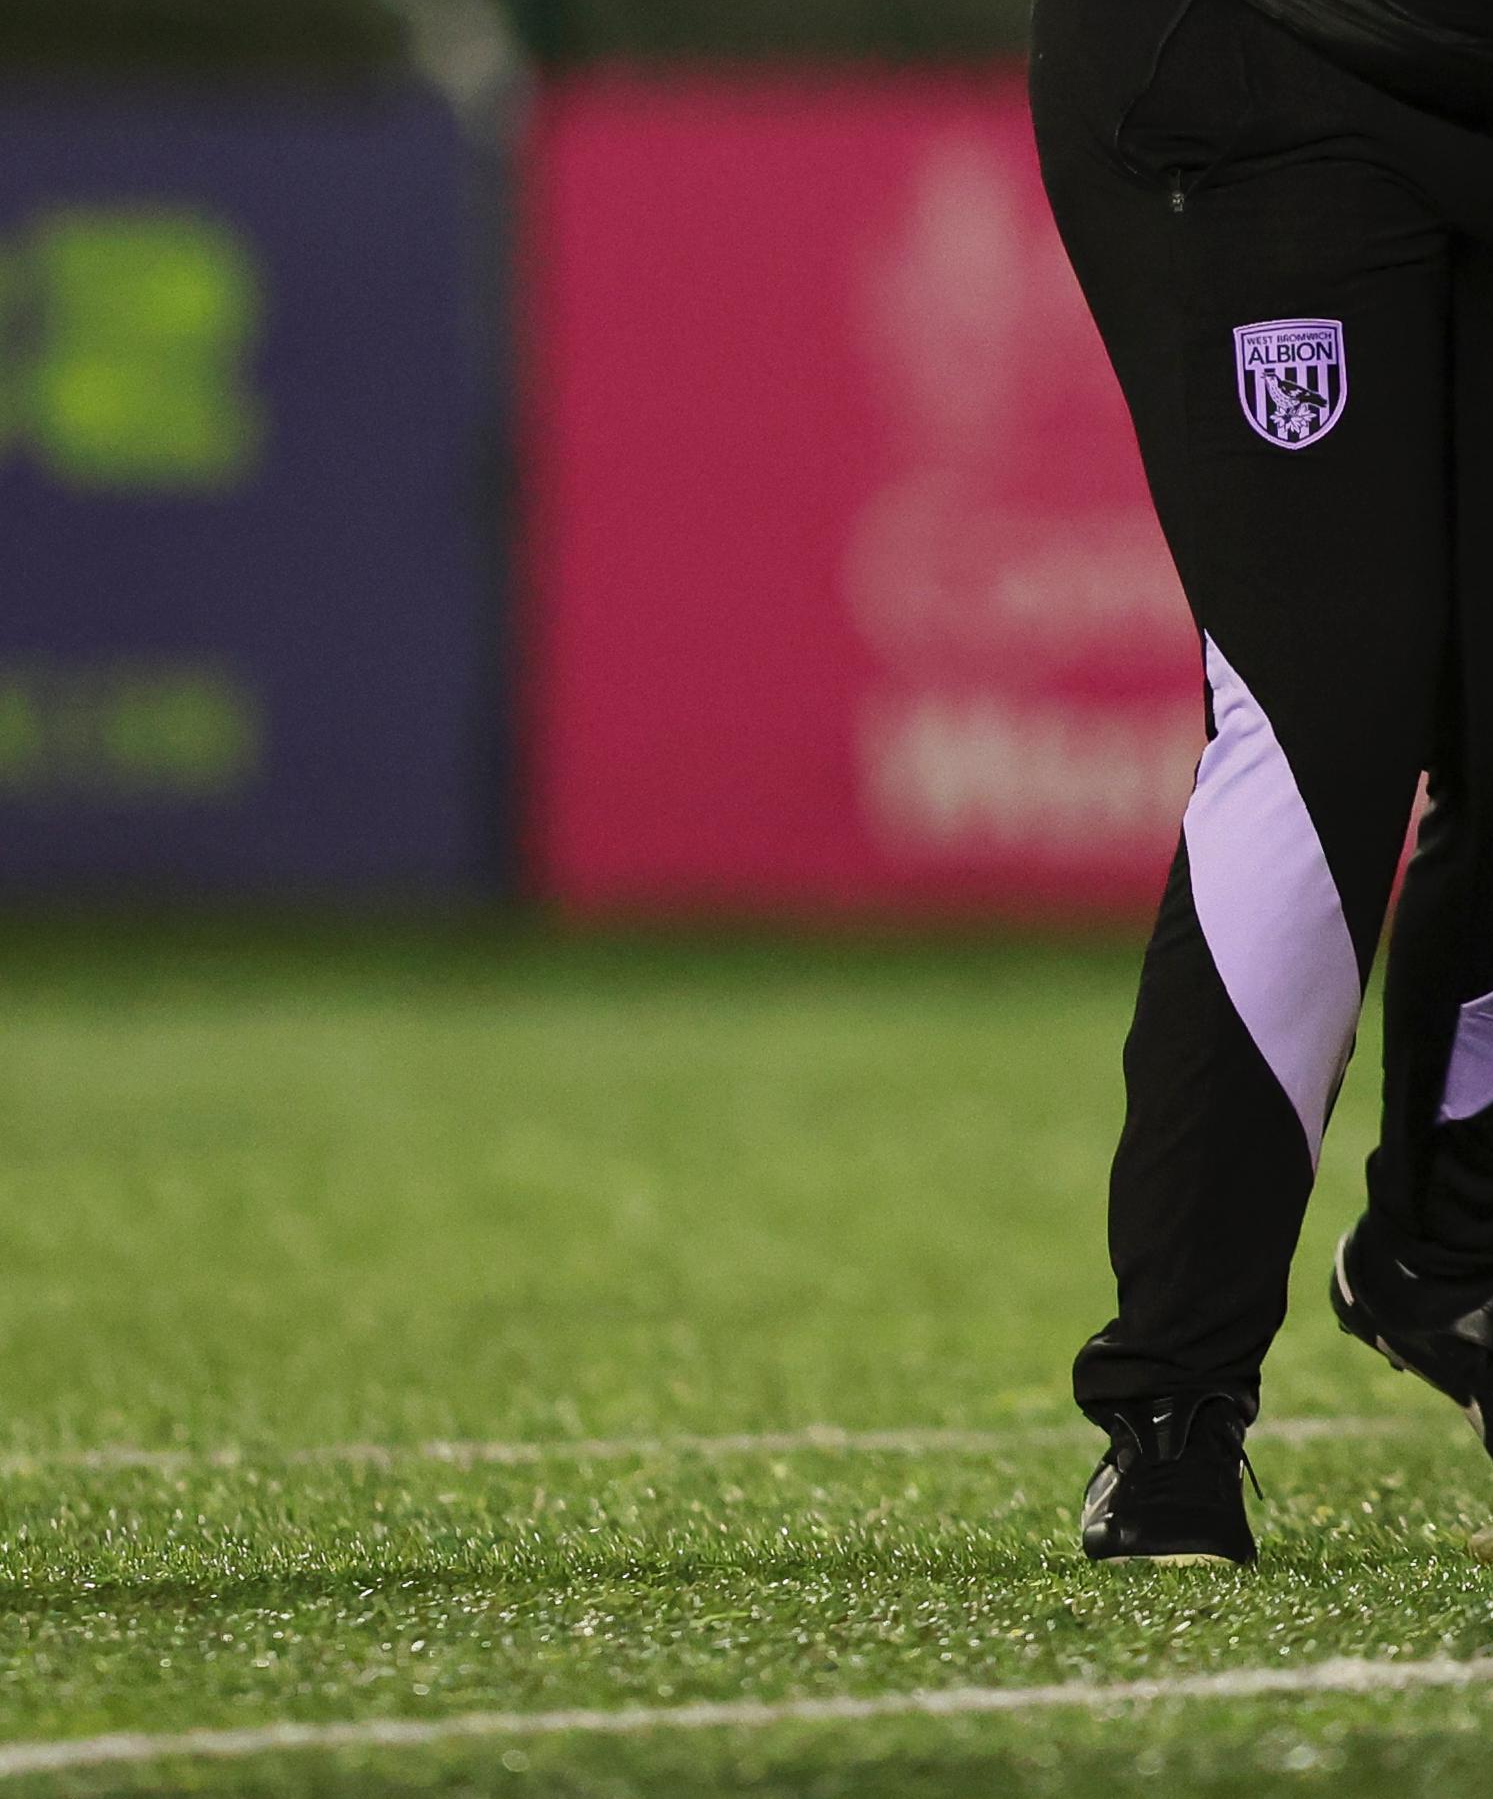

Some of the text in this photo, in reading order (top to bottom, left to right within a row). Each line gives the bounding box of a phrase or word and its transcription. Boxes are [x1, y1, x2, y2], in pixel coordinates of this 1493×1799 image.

[1247, 331, 1332, 345] WEST BROMWICH
[1248, 341, 1333, 365] ALBION
